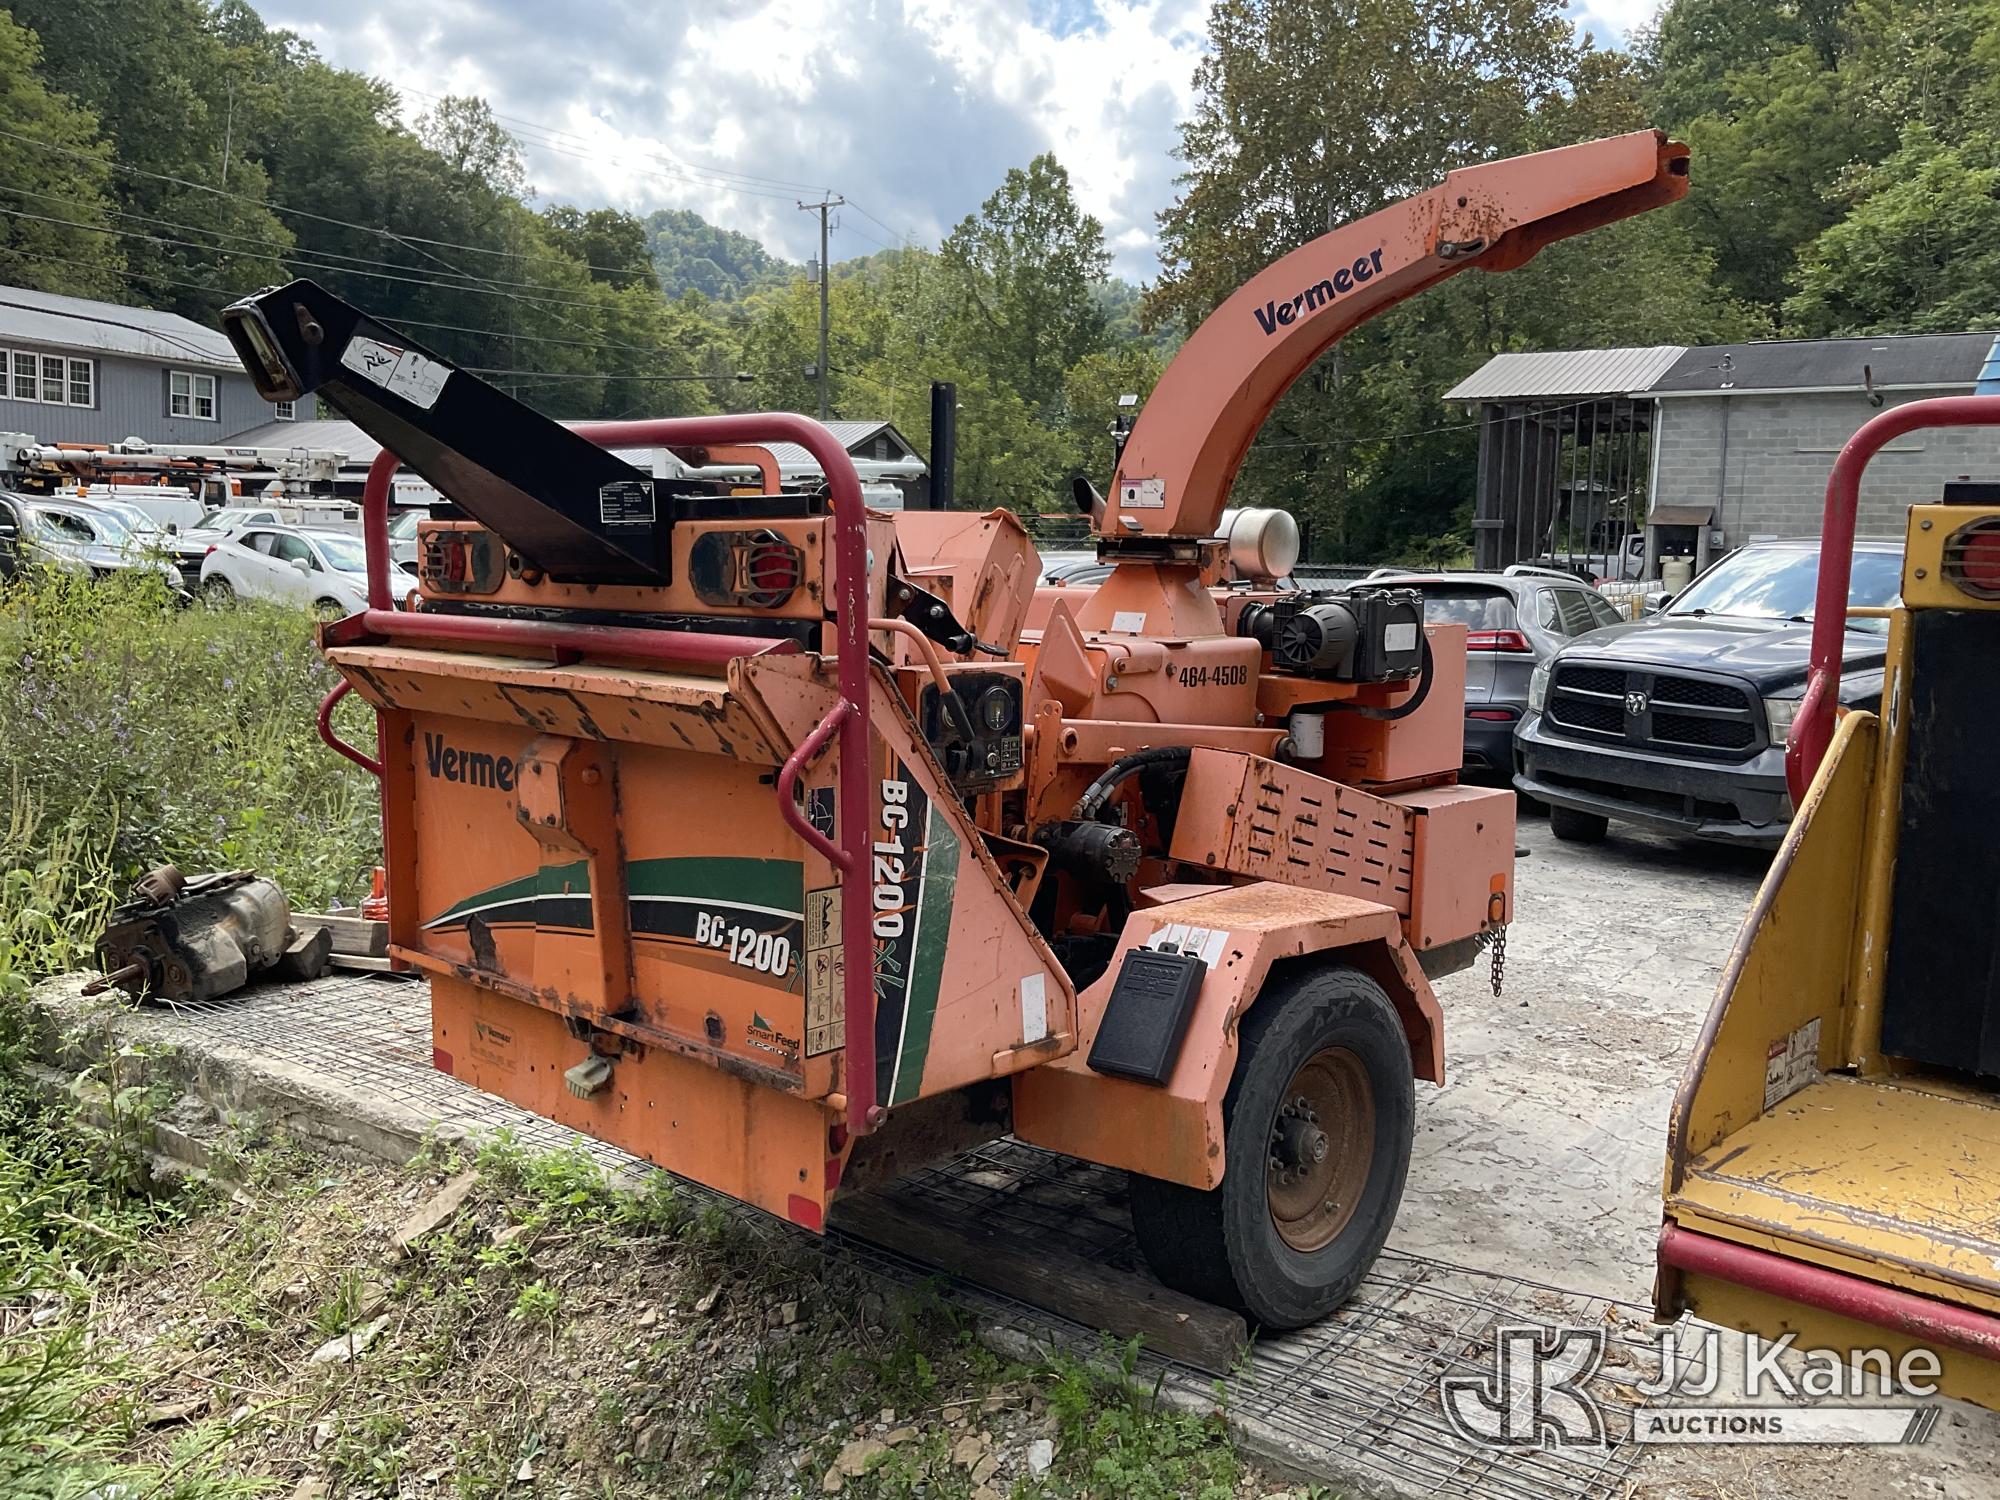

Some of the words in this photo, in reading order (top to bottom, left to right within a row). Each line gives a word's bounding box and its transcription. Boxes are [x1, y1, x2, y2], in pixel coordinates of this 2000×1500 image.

[1253, 247, 1383, 336] Vermeer
[1179, 665, 1248, 688] 464-4508
[424, 731, 519, 792] Verme
[882, 779, 909, 829] BC
[873, 835, 906, 938] 1200
[695, 911, 726, 948] BC
[727, 925, 791, 976] 1200
